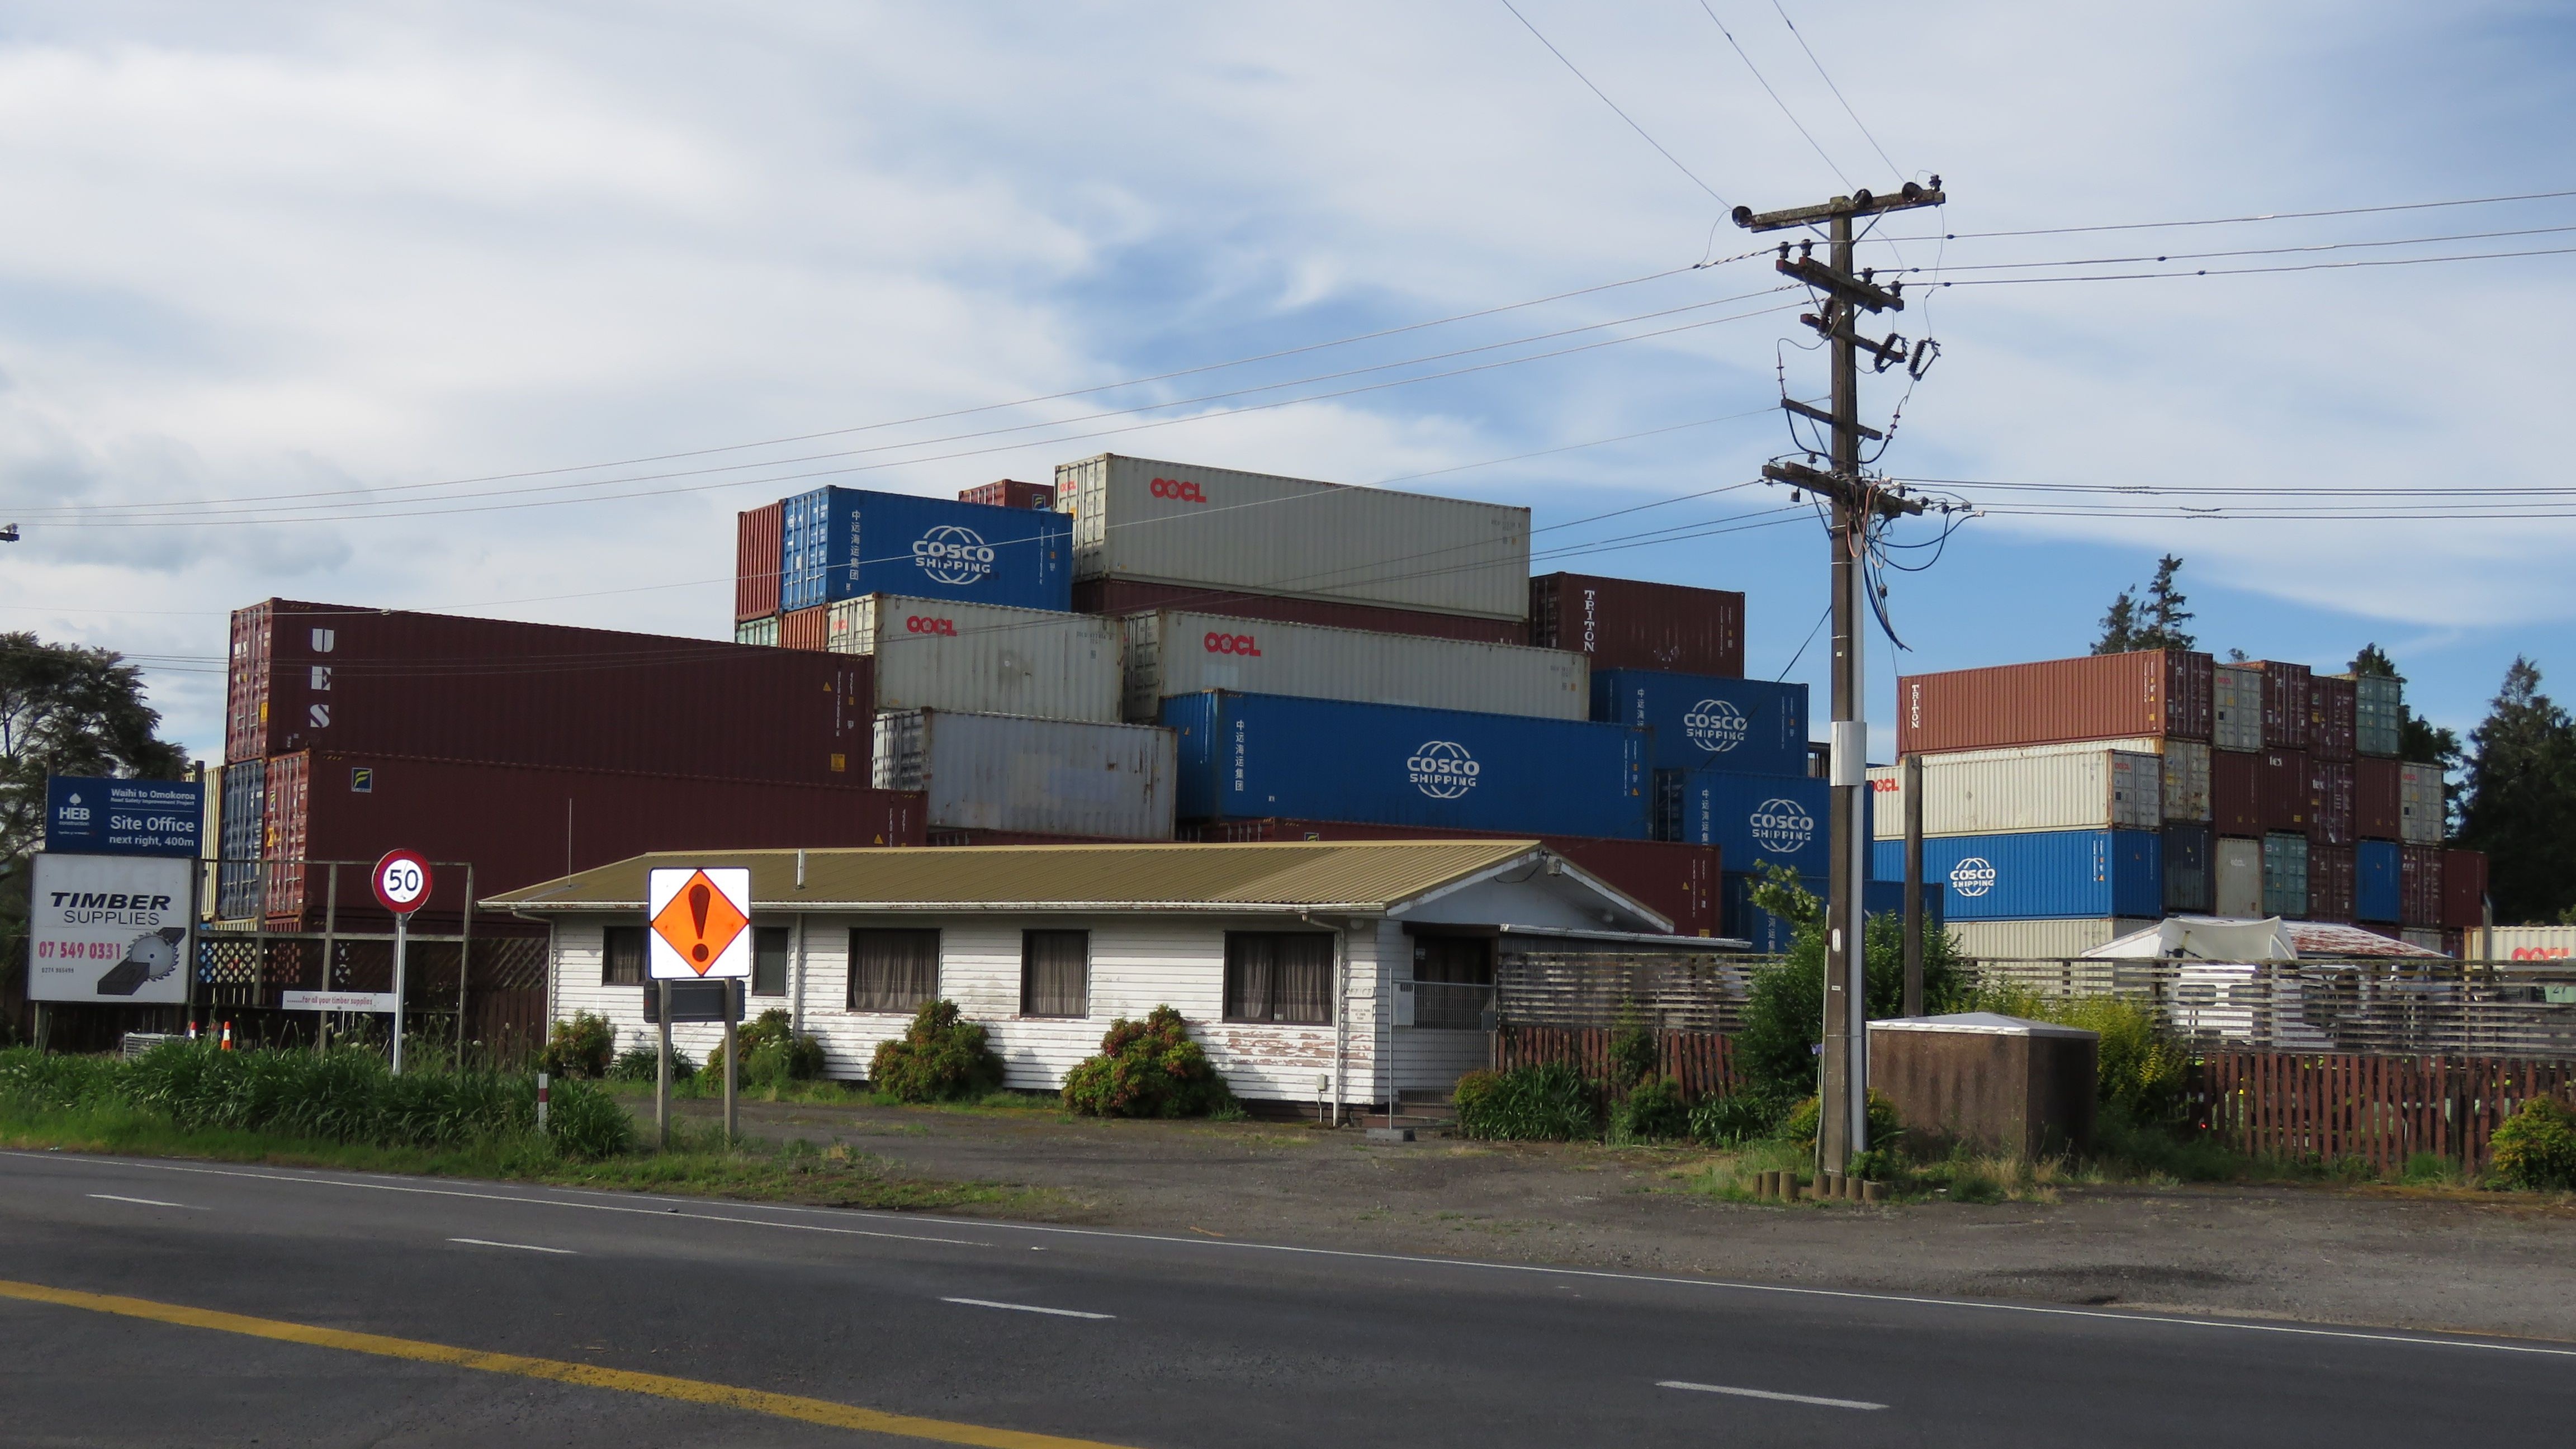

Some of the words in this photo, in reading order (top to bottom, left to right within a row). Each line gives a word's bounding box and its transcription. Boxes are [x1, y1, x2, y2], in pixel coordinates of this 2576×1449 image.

[1150, 477, 1206, 503] OOCL
[850, 510, 860, 581] 中远海运集团
[912, 541, 995, 563] COSCO
[915, 557, 991, 574] SHIPPING
[907, 615, 957, 636] OOCL
[1584, 590, 1595, 652] TRITON
[1204, 632, 1261, 656] OOCL
[309, 628, 335, 728] UES
[1684, 713, 1748, 731] COSCO
[1686, 728, 1744, 741] SHIPPING
[1235, 719, 1244, 792] 中远海运集团
[1407, 756, 1480, 776] COSCO
[1409, 773, 1476, 787] SHIPPING
[111, 788, 136, 798] Waihi
[150, 790, 196, 800] Omokoroa
[59, 807, 91, 820] HEB
[1750, 813, 1814, 831] COSCO
[111, 815, 143, 830] Site
[146, 816, 195, 832] Office
[109, 836, 132, 845] next
[135, 835, 162, 847] right,
[164, 837, 195, 847] 400m
[1752, 829, 1811, 841] SHIPPING
[389, 870, 419, 892] 50
[1950, 868, 1996, 880] COSCO
[1952, 879, 1994, 888] SHIPPING
[50, 892, 172, 911] TIMBER
[63, 910, 160, 926] SUPPLIES
[39, 941, 55, 959] 07
[60, 942, 85, 959] 549
[89, 943, 121, 960] 0331
